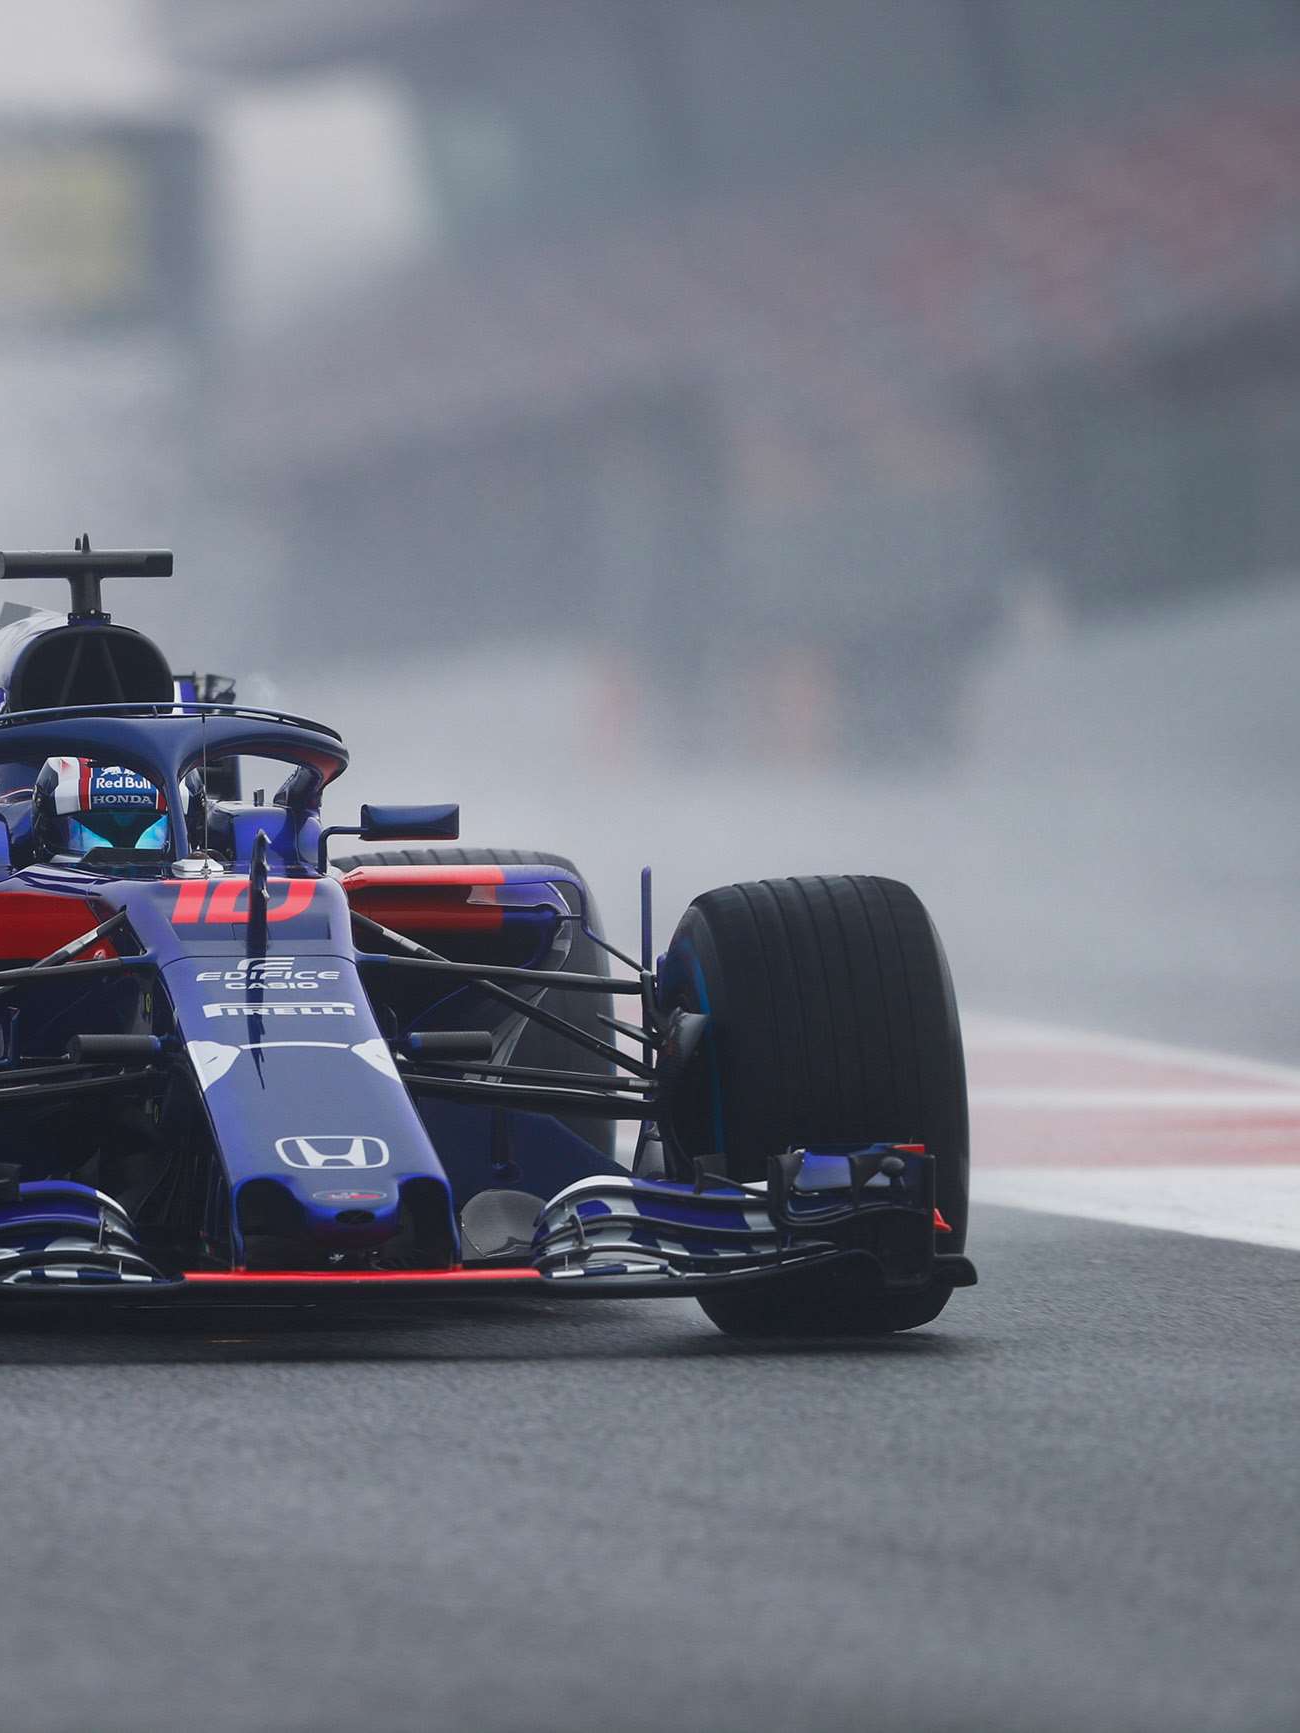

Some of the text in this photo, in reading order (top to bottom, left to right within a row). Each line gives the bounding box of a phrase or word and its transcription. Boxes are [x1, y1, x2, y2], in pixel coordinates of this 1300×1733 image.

[96, 777, 151, 789] Red Bull
[92, 795, 154, 805] HONDA
[163, 880, 317, 924] 10
[196, 970, 341, 982] EDIFICE
[225, 982, 319, 990] CASIO
[202, 1002, 356, 1018] PIRELLI
